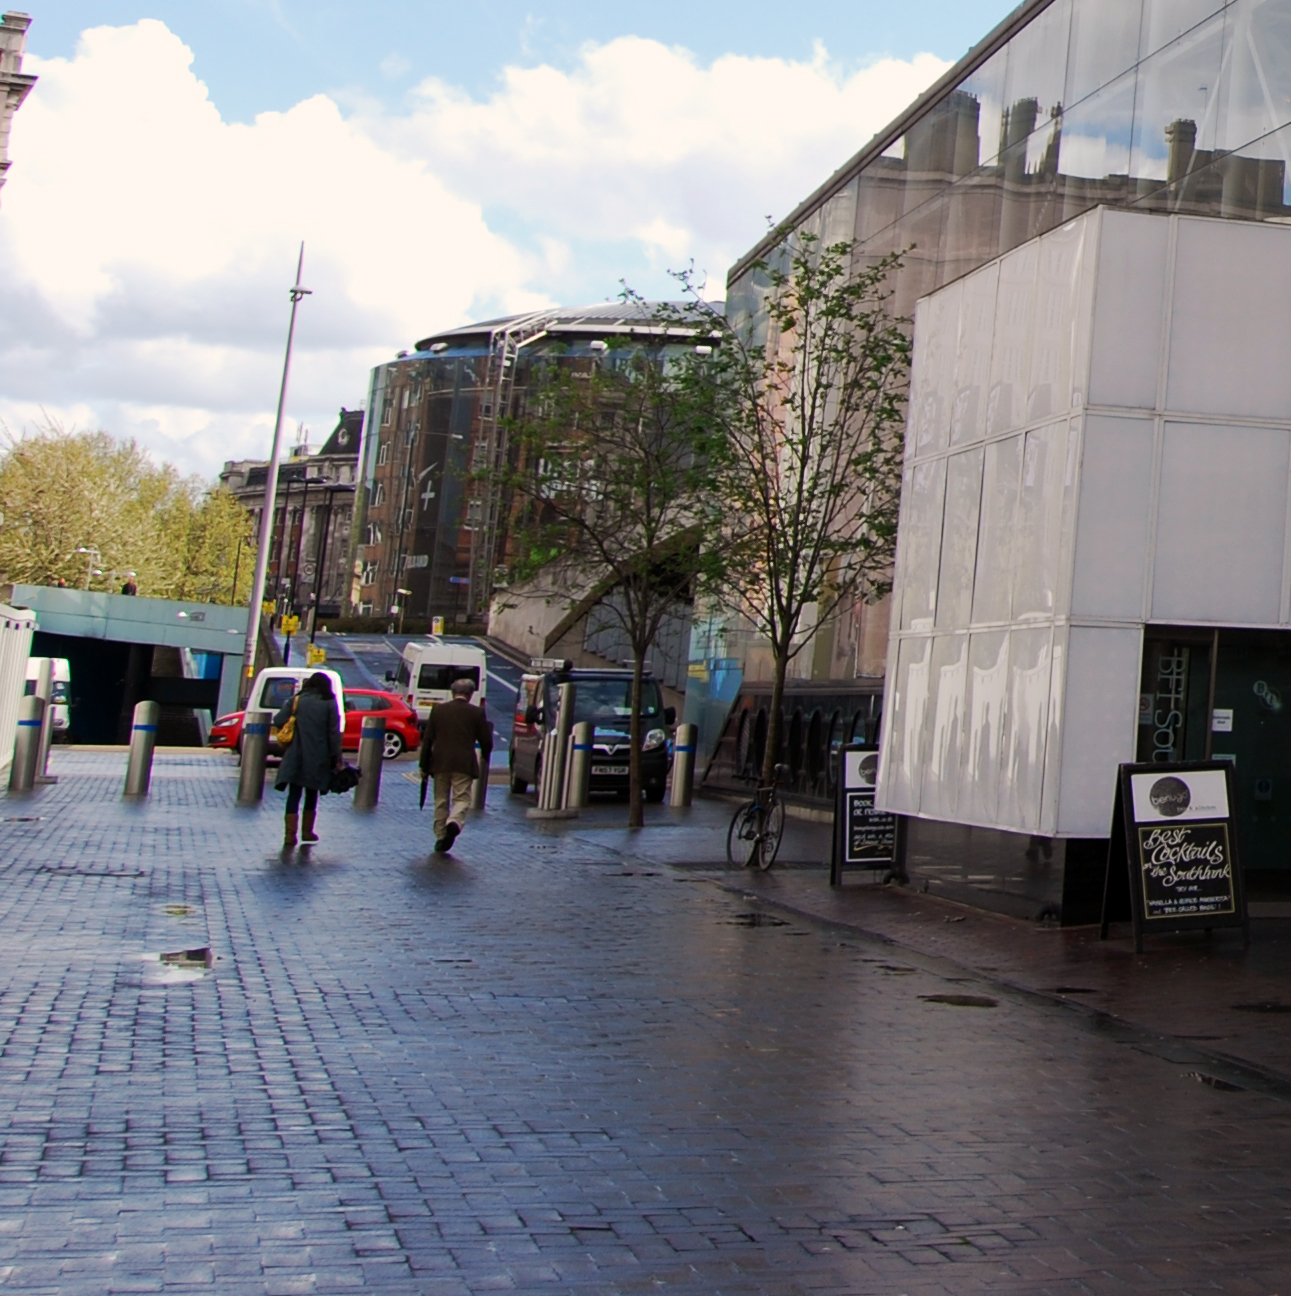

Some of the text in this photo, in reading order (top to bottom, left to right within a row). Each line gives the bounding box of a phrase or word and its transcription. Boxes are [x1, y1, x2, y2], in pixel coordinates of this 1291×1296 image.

[1157, 656, 1186, 701] BFI
[1143, 827, 1192, 850] Best
[1151, 840, 1224, 865] Cocktails
[1150, 865, 1168, 878] the
